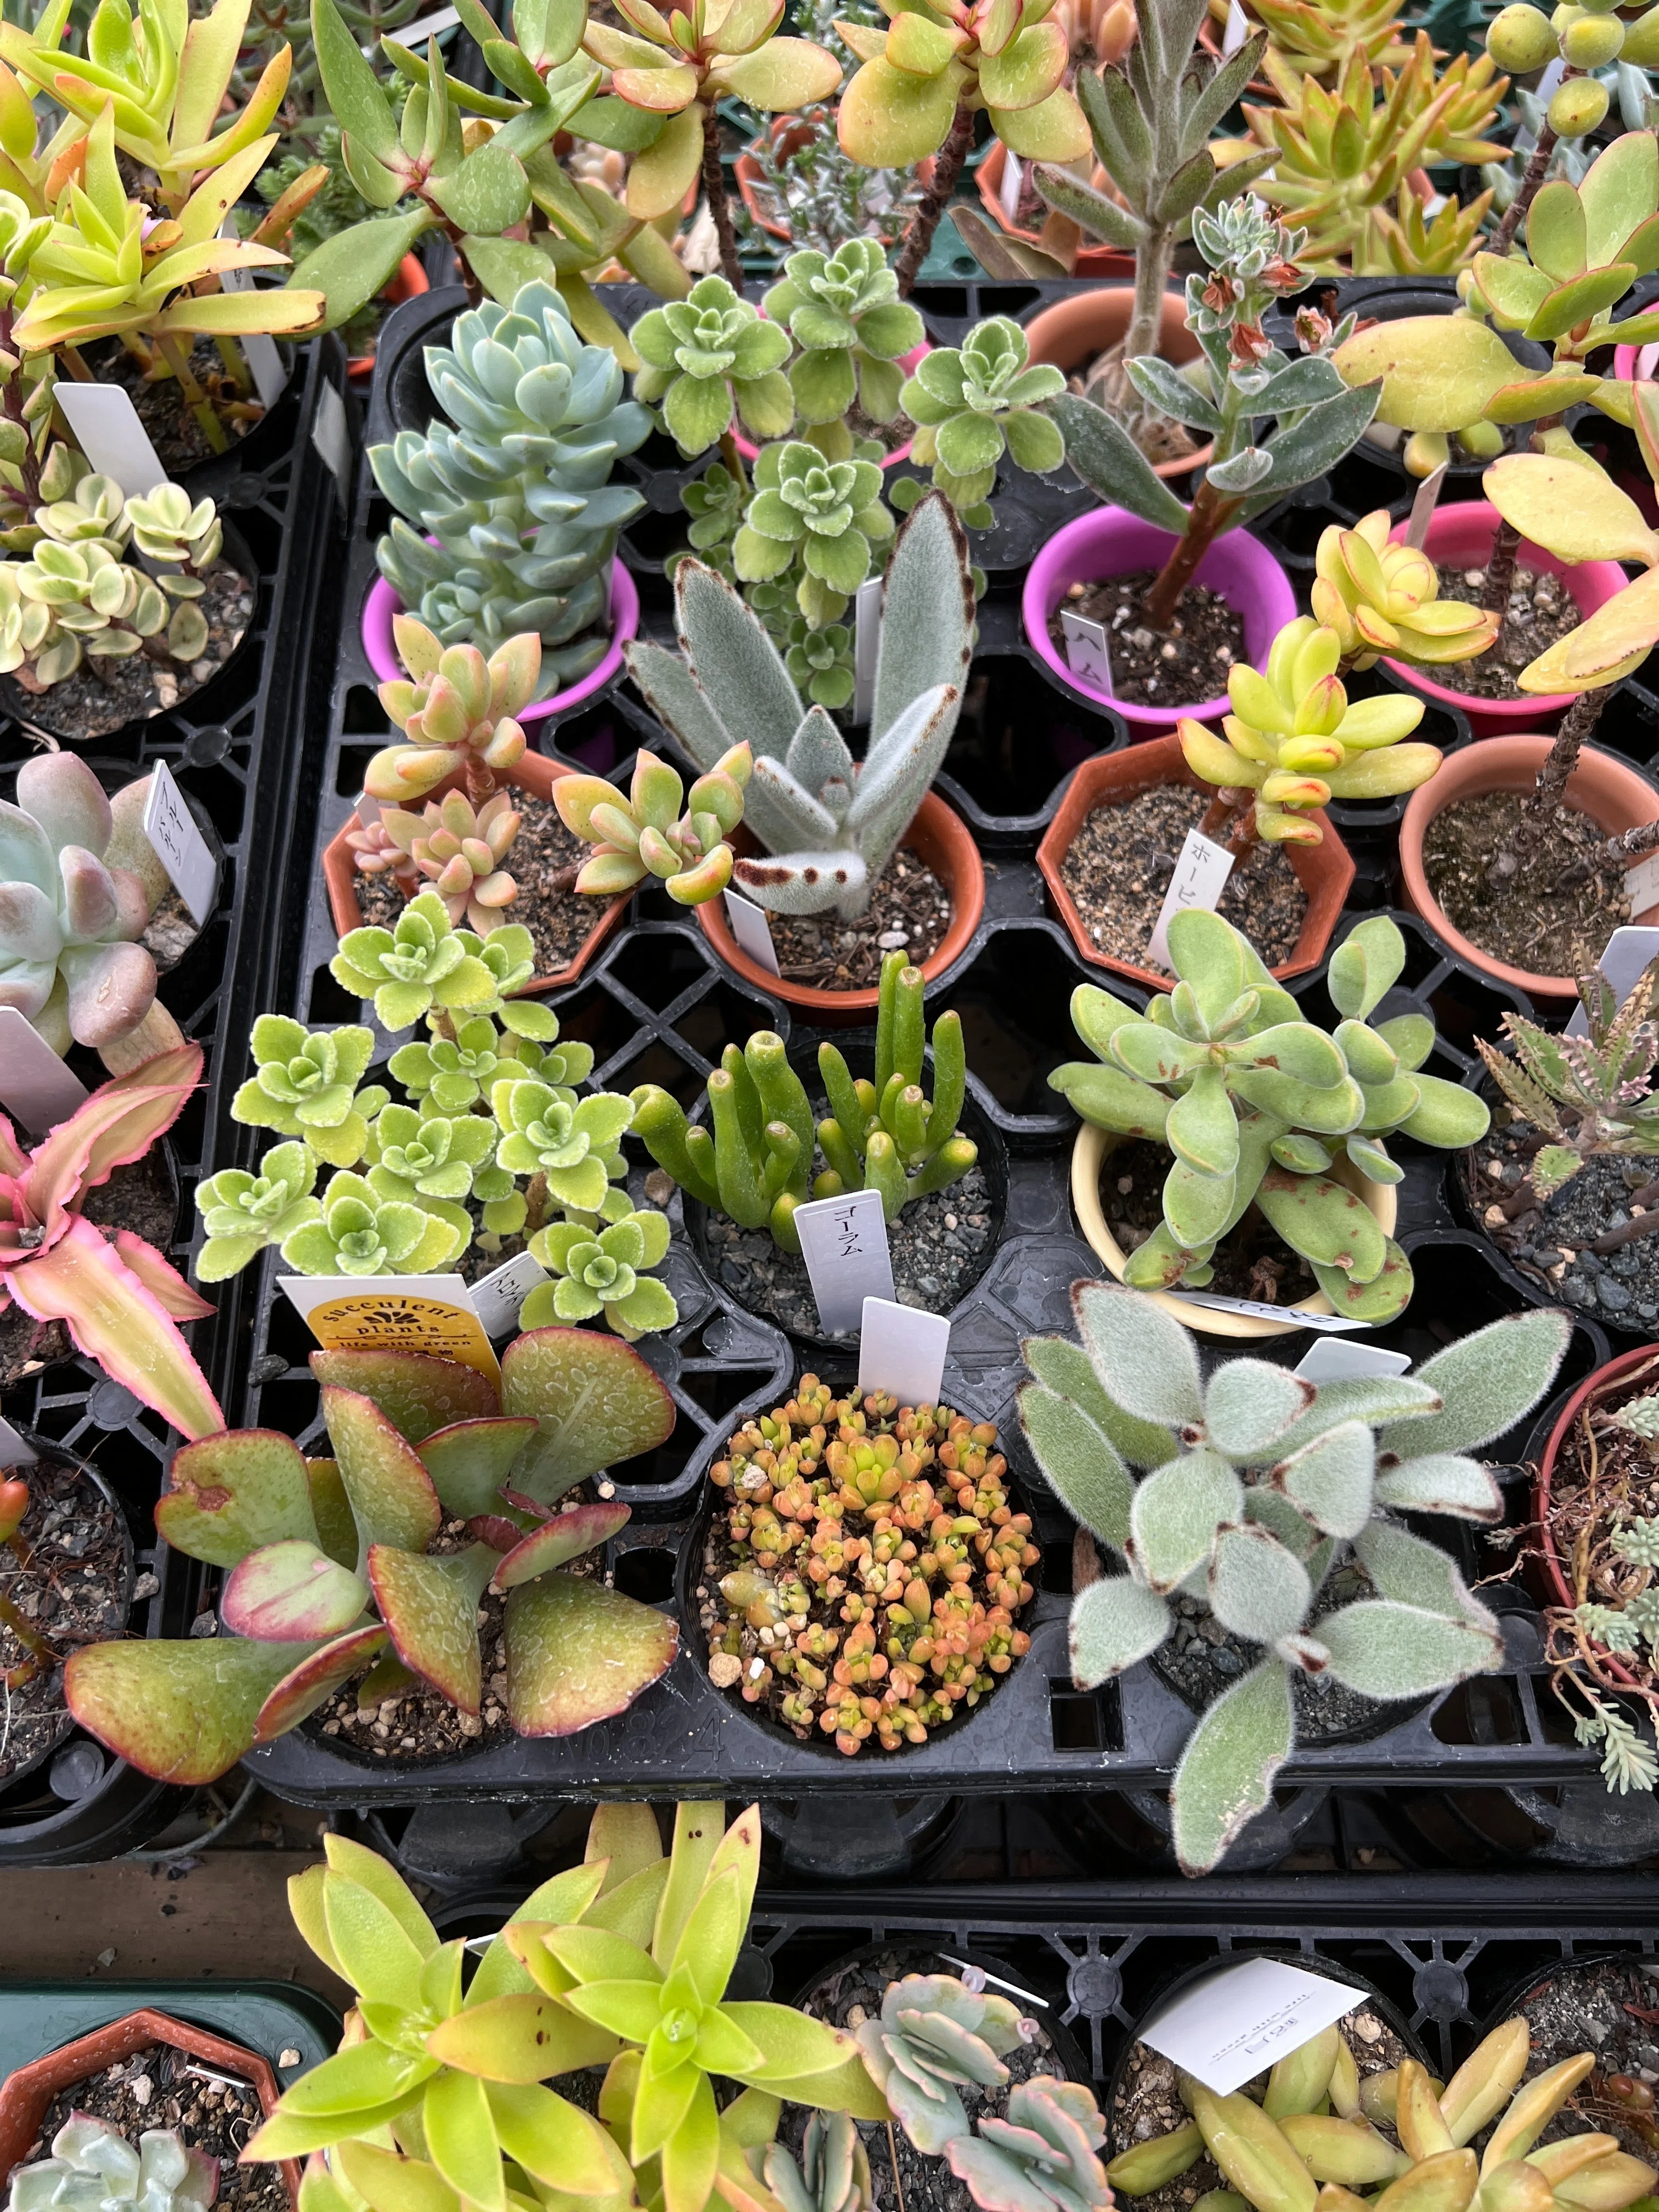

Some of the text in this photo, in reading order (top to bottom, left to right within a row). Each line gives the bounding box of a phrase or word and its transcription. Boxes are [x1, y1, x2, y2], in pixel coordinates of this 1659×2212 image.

[1175, 844, 1211, 912] ホービ
[323, 1299, 461, 1322] succulent
[356, 1325, 439, 1335] plants
